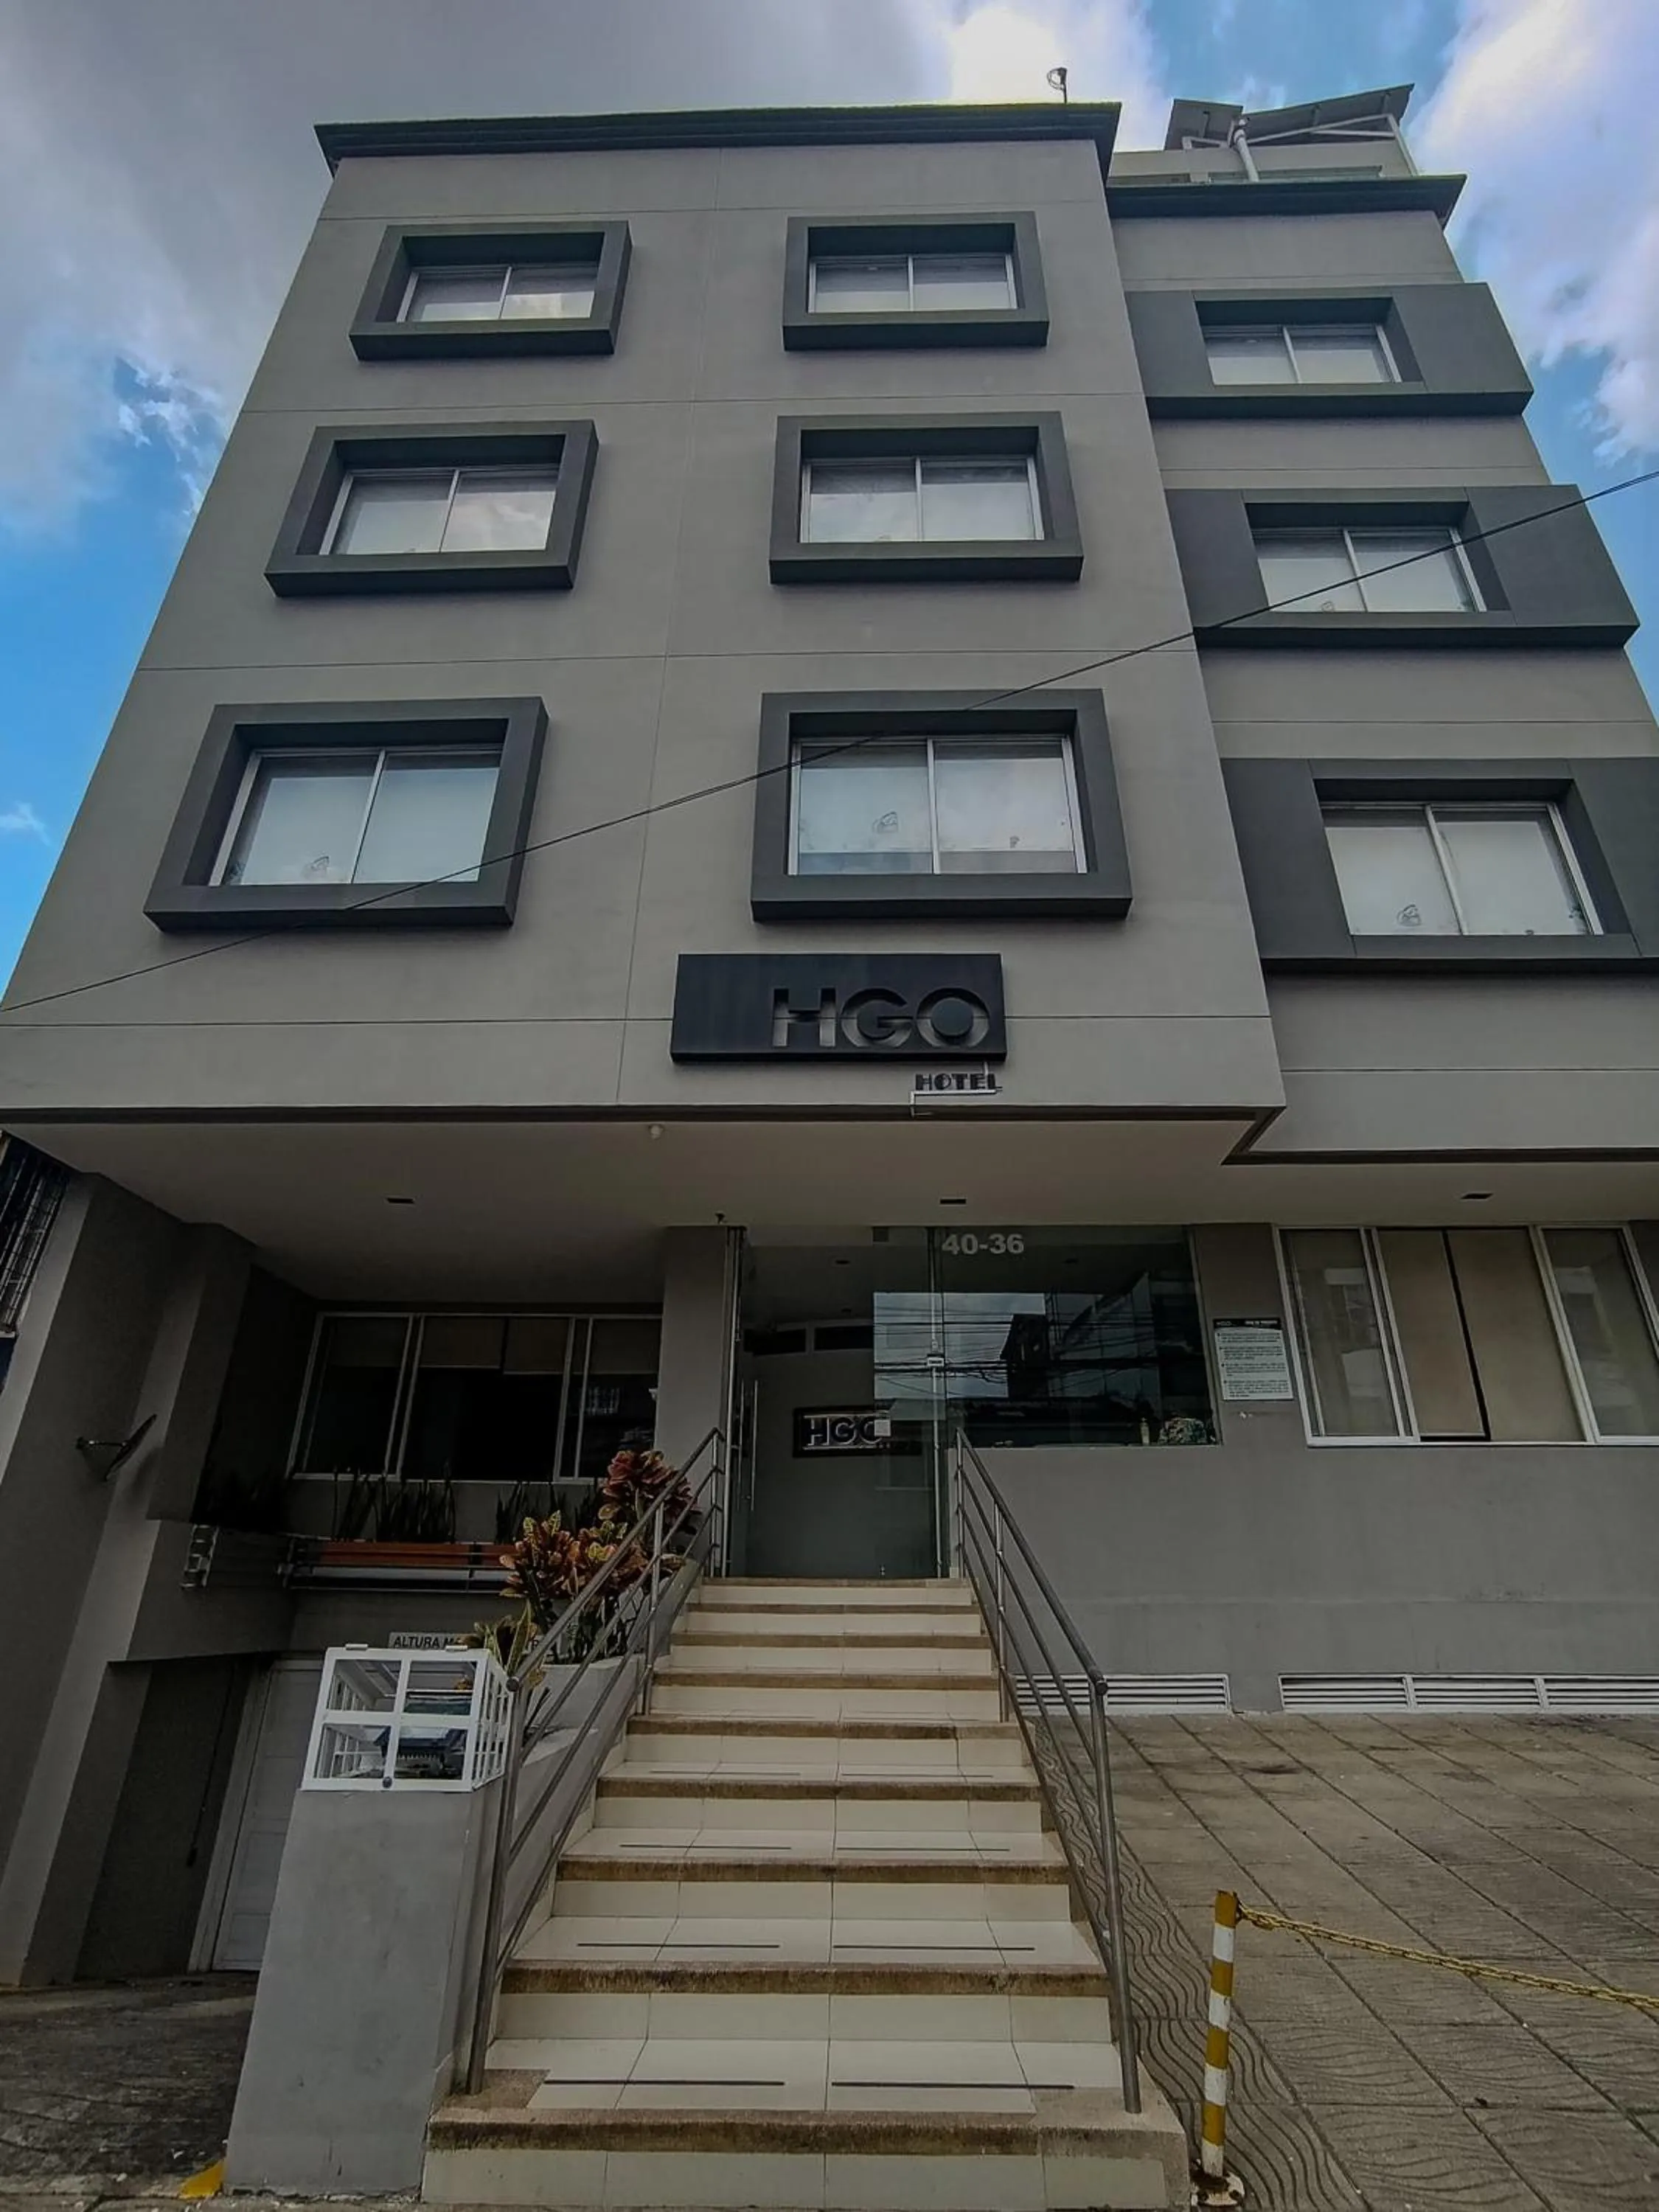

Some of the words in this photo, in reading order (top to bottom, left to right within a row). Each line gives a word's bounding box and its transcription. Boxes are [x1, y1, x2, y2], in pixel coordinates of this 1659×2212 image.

[772, 987, 990, 1048] HGO
[915, 1074, 997, 1091] HOTEL
[942, 1233, 1025, 1255] 40-36
[393, 1635, 441, 1649] ALTURA
